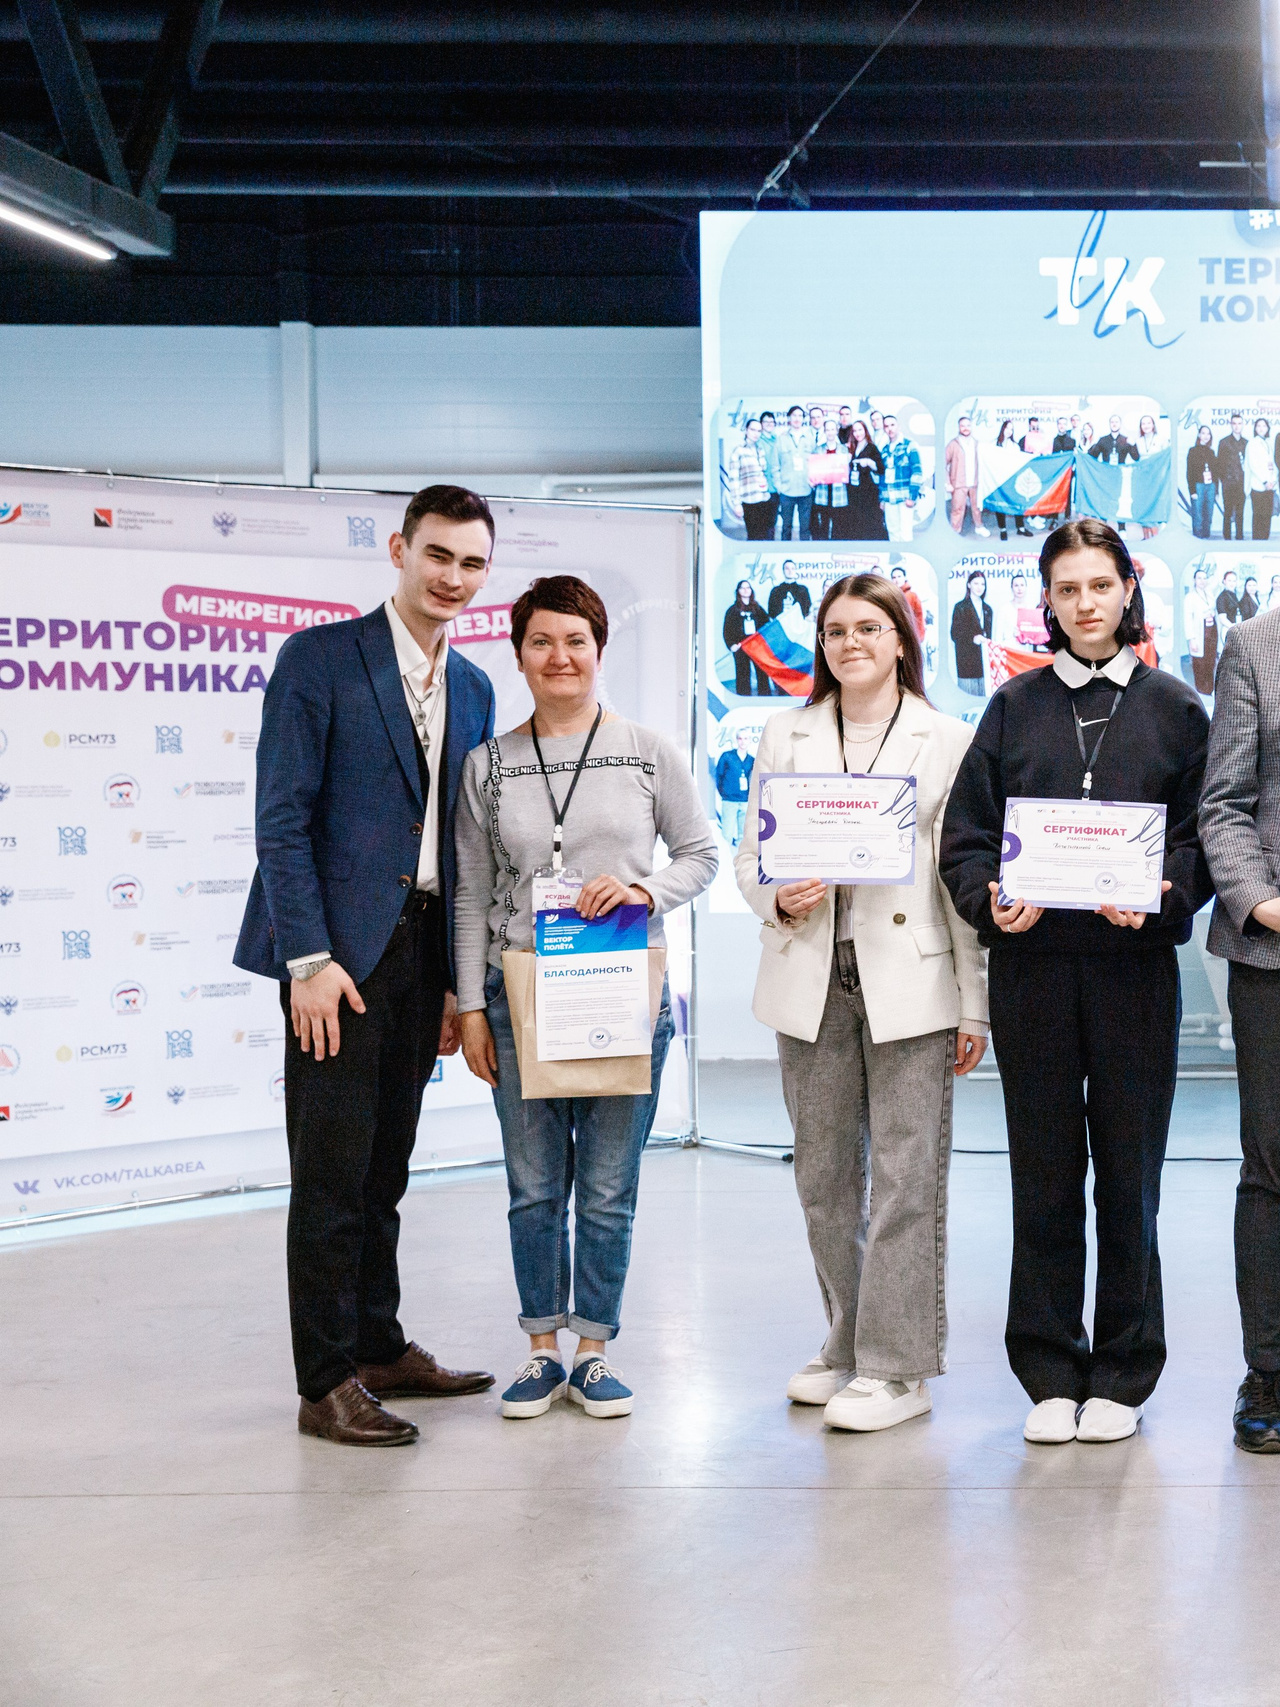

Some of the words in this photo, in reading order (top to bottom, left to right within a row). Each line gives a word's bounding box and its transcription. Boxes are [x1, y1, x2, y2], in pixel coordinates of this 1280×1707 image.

[961, 556, 1024, 566] РИТОРИЯ
[0, 617, 267, 653] ЕРРИТОРИЯ
[0, 658, 268, 693] ОММУНИКА
[155, 725, 182, 737] 100
[68, 733, 117, 745] РСМ73
[796, 800, 879, 809] СЕРТИФИКАТ
[58, 826, 87, 838] 100
[1043, 824, 1128, 836] СЕРТИФИКАТ
[61, 930, 91, 942] 100
[543, 943, 574, 951] ПОЛЁТА
[543, 965, 633, 979] БЛАГОДАРНОСТЬ
[166, 1029, 193, 1041] 100
[80, 1043, 127, 1057] РСМ73
[54, 1160, 206, 1190] VK.COM/TALKAREA
